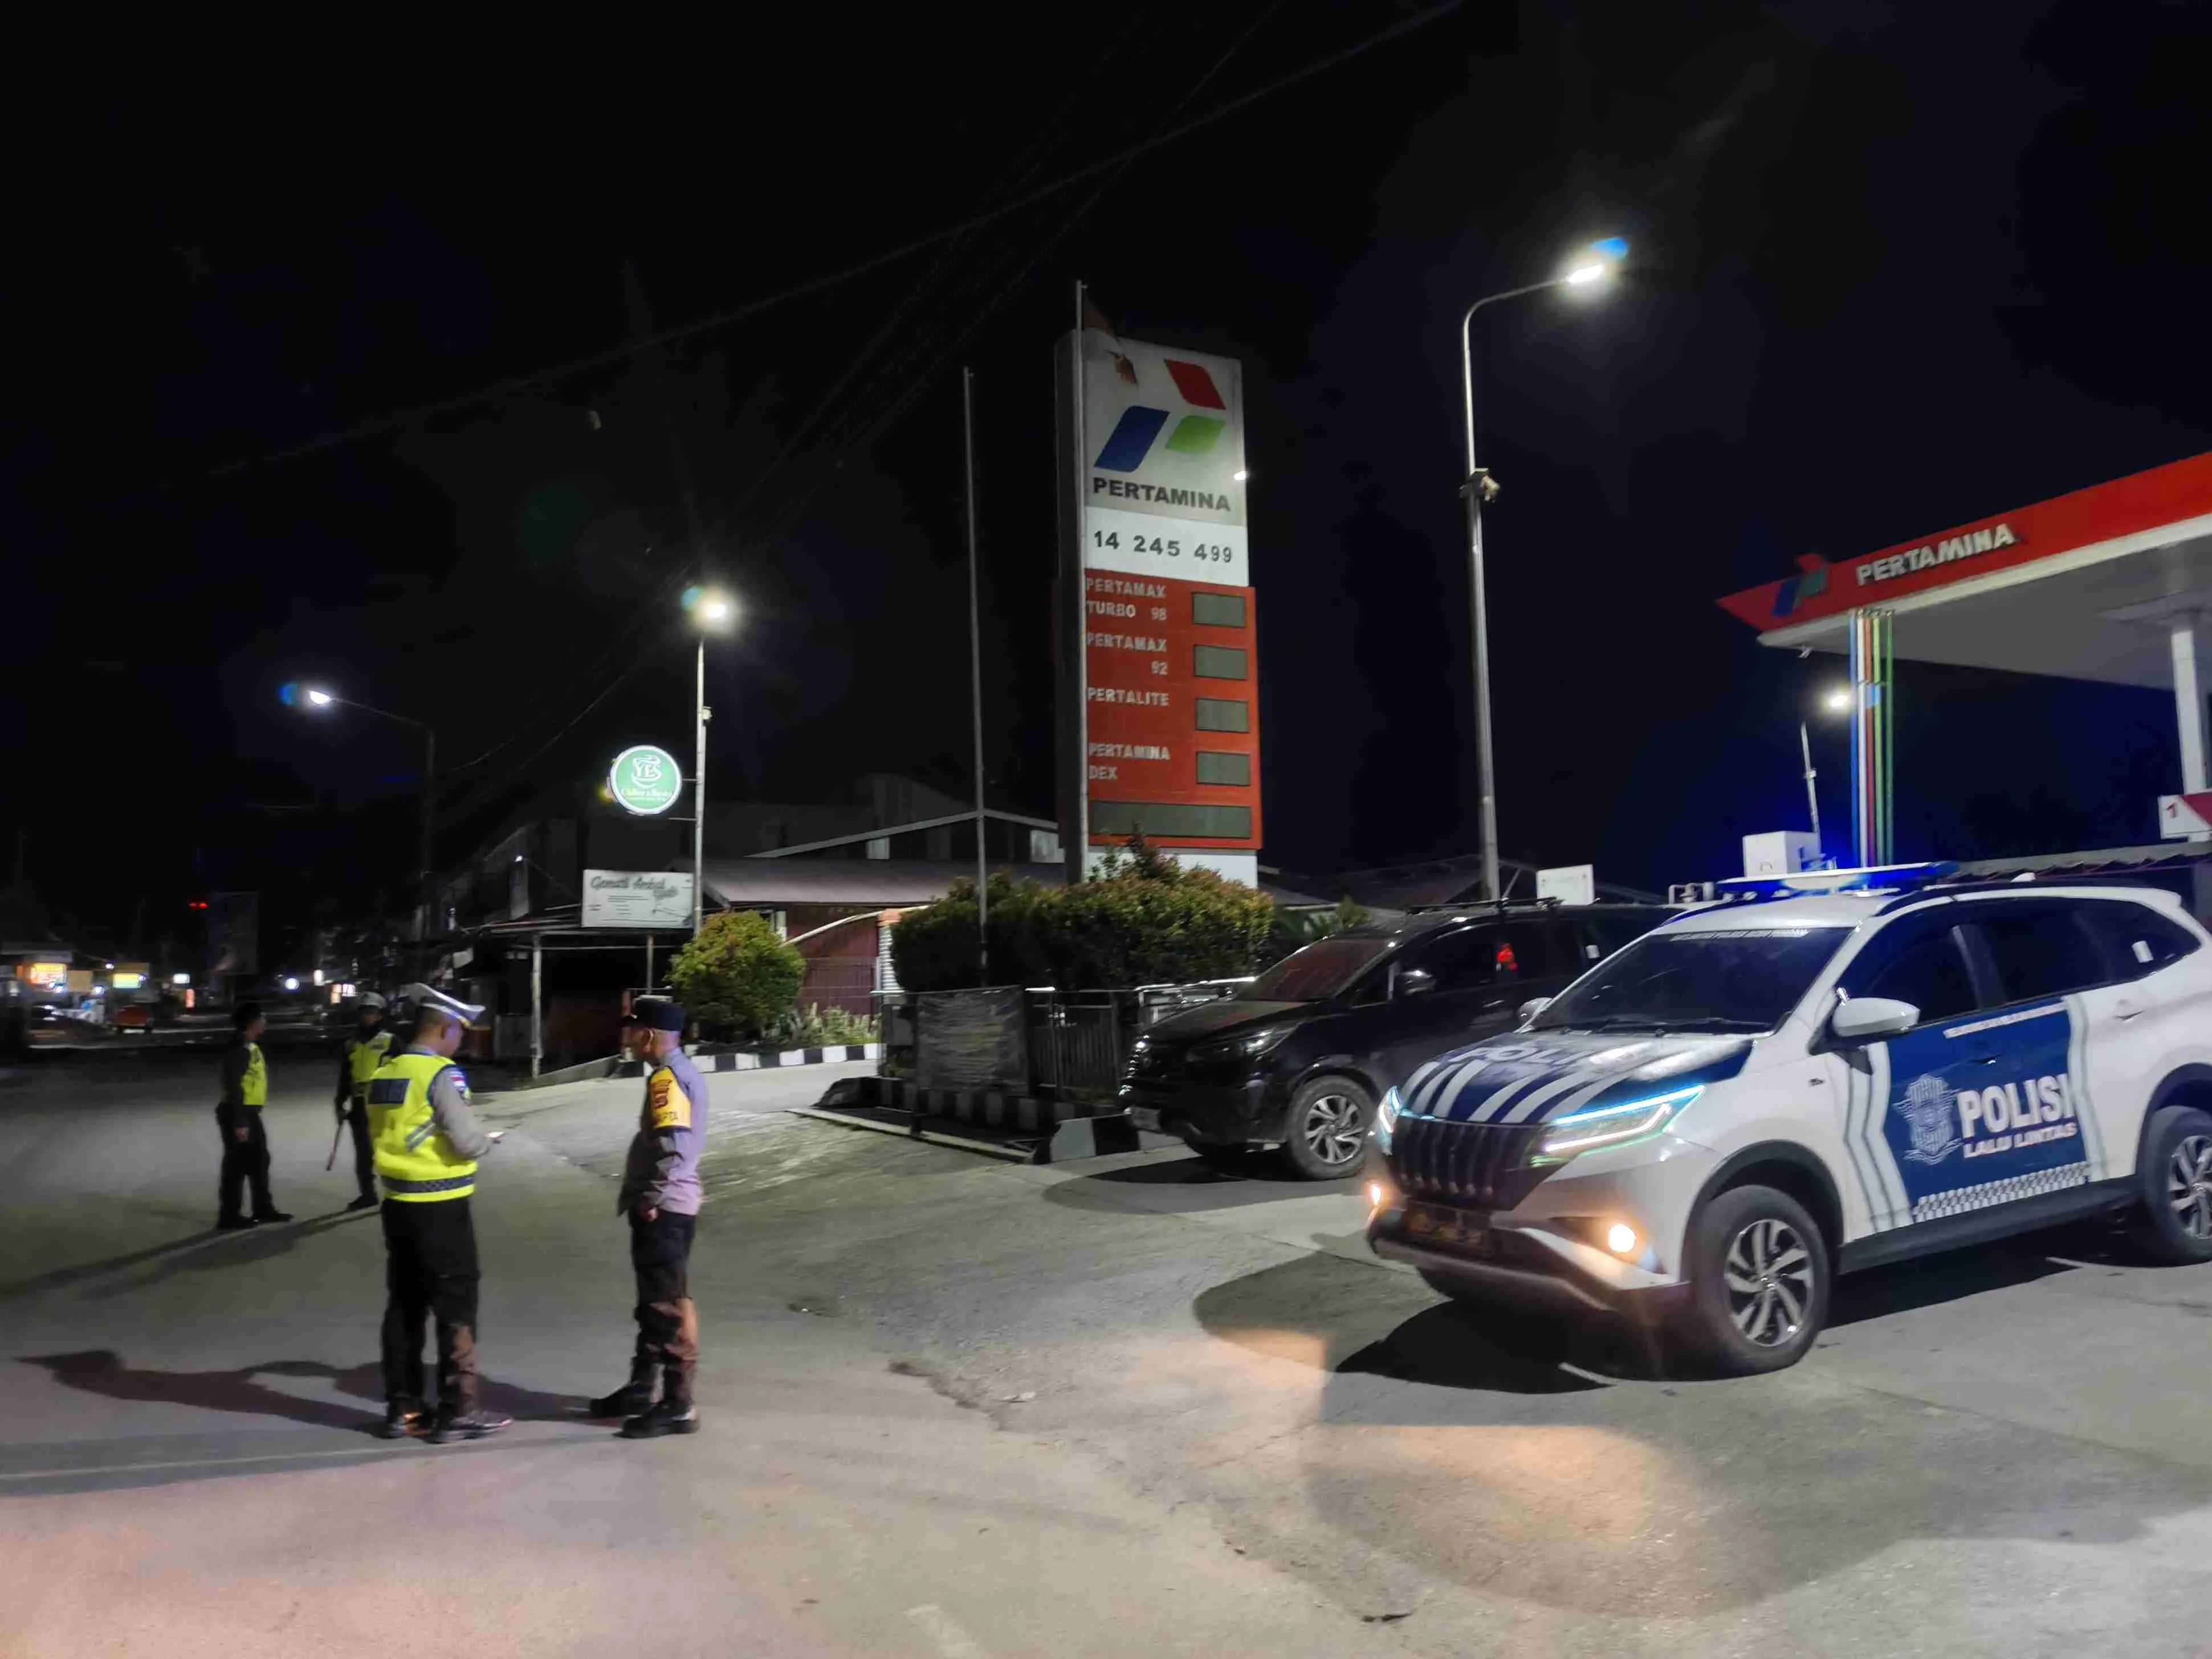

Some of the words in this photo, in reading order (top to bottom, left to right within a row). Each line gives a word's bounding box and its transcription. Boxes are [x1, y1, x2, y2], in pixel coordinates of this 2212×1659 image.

[1094, 478, 1231, 511] PERTAMINA
[1095, 530, 1119, 549] 14
[1134, 535, 1180, 556] 245
[1194, 544, 1232, 563] 499
[1857, 523, 2015, 585] PERTAMINA
[1086, 578, 1166, 597] PERTAMAX
[1086, 601, 1136, 617] TURBO
[1151, 608, 1167, 621] 98
[1086, 633, 1167, 652] PERTAMAX
[1087, 688, 1169, 705] PERTALITE
[1089, 743, 1170, 760] PERTAMINA
[1089, 766, 1118, 779] DEX
[2166, 803, 2177, 818] 1
[1957, 1074, 2075, 1138] POLISI
